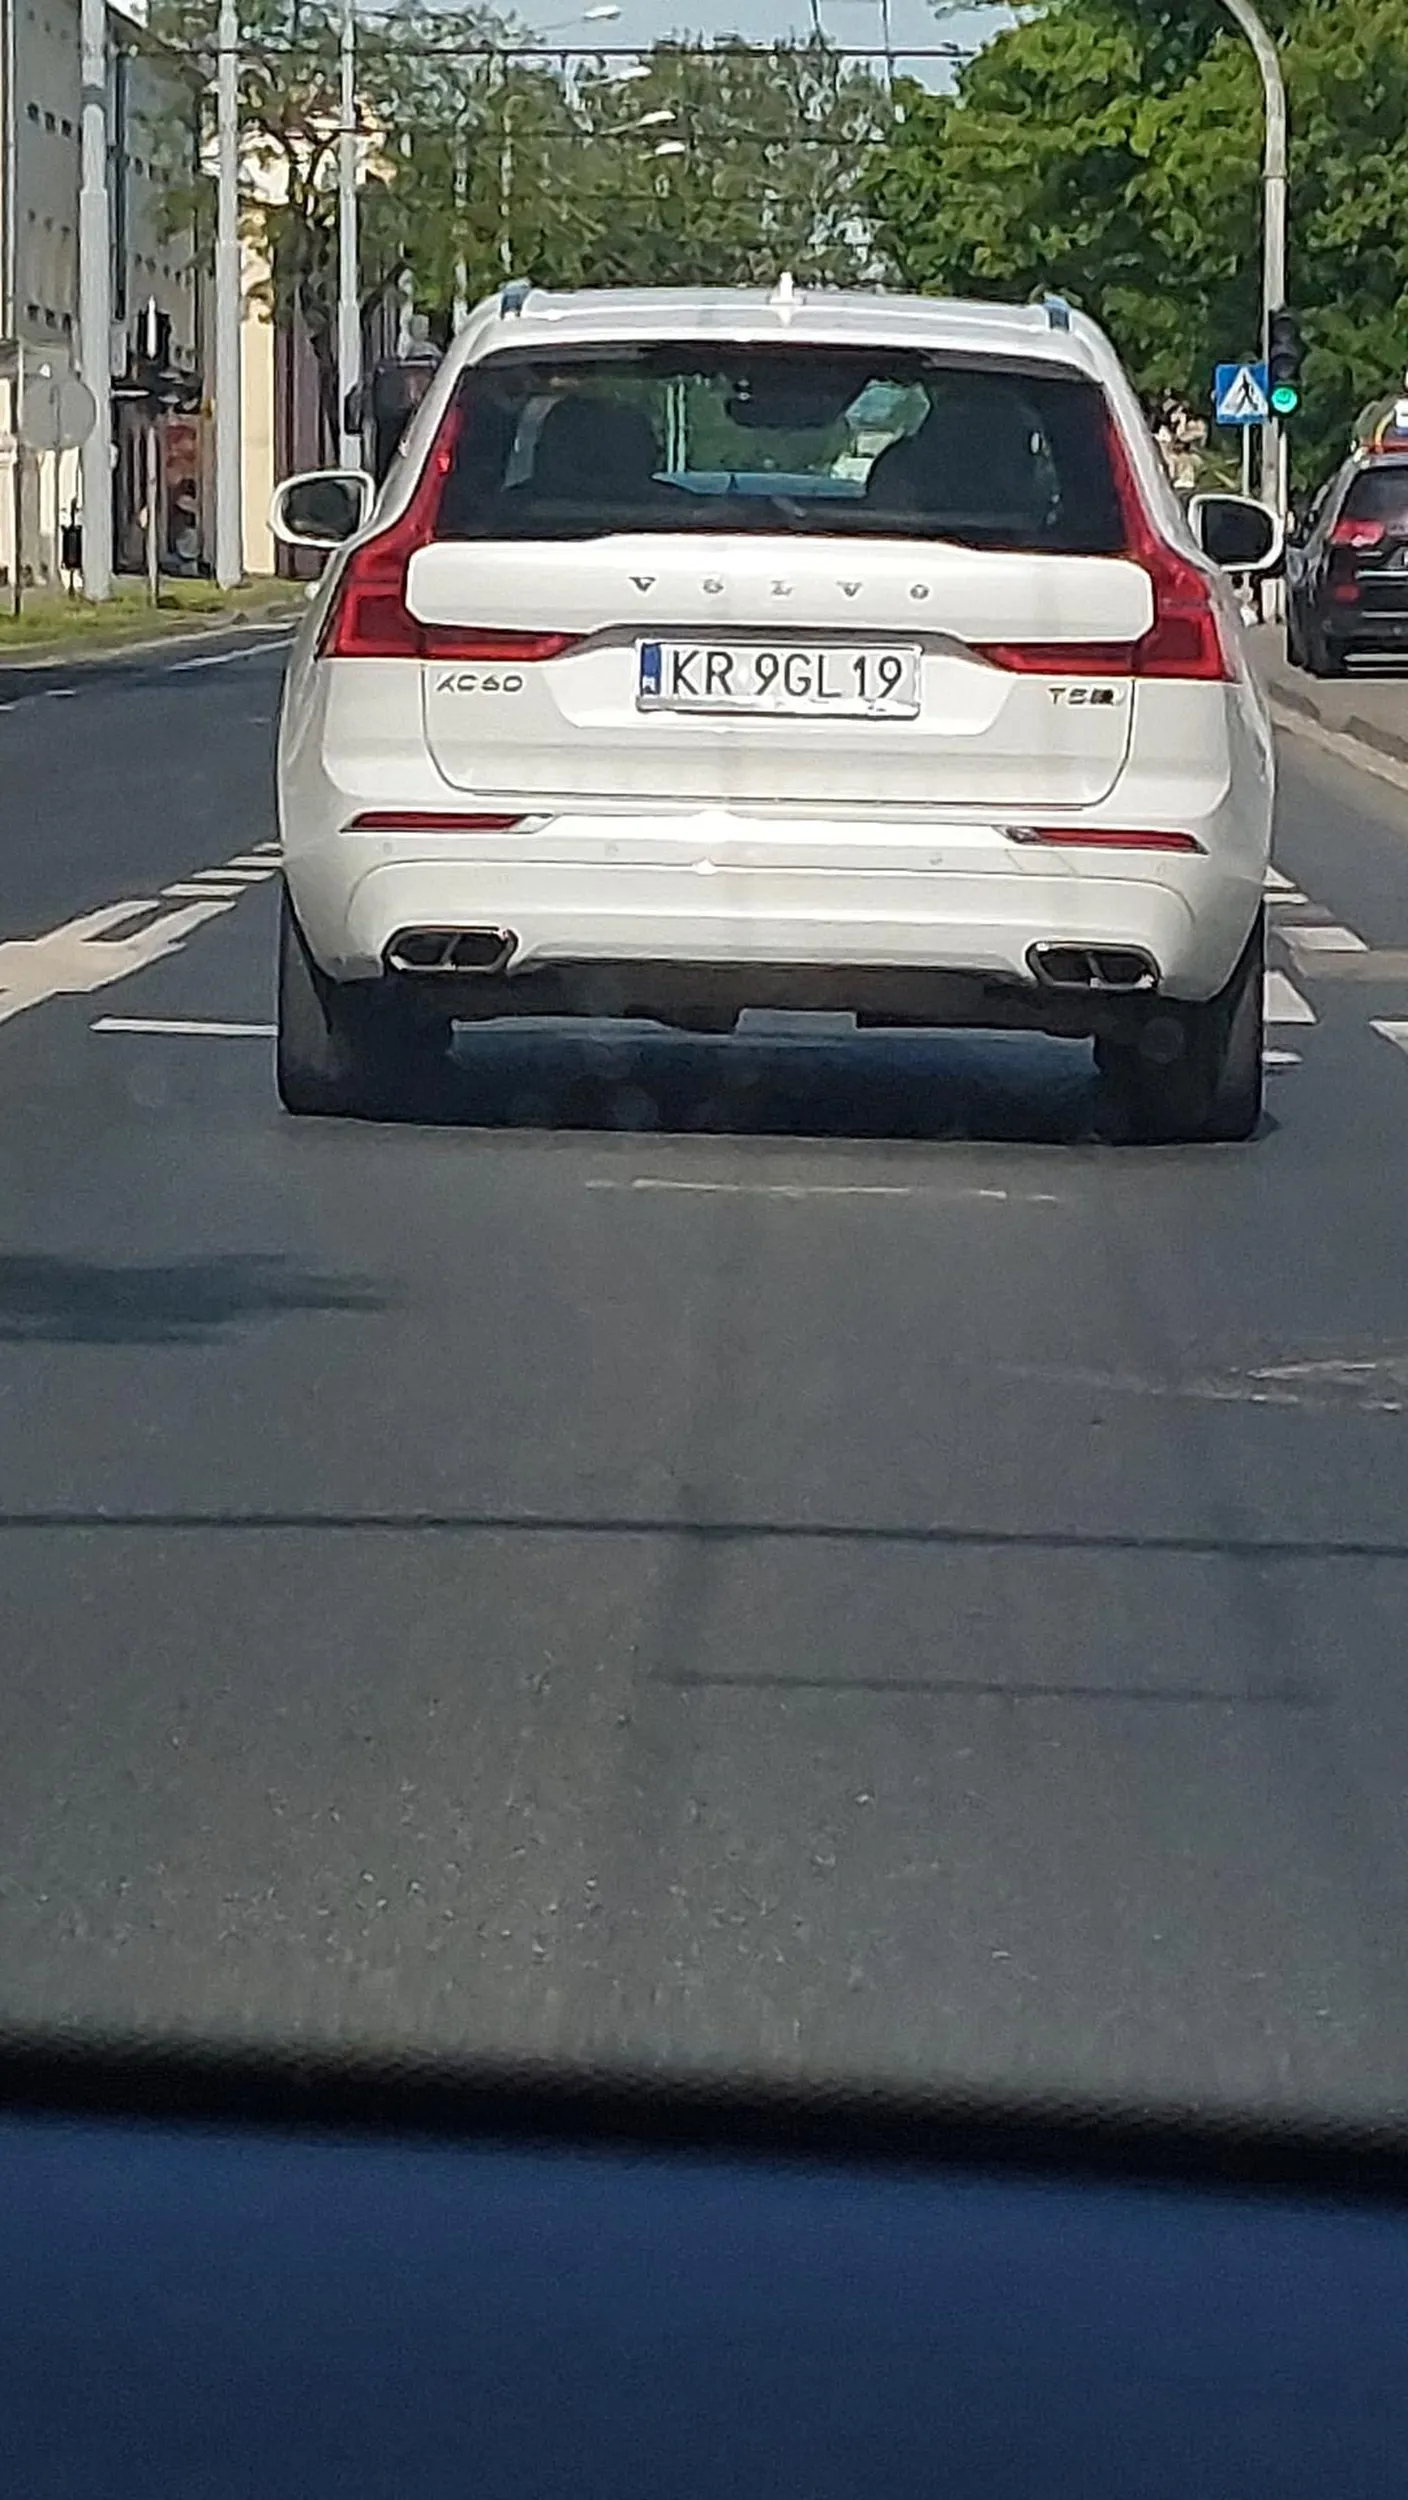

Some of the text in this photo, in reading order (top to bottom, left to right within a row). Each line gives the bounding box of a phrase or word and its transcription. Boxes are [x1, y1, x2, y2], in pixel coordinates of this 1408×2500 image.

[629, 576, 929, 599] VOLVO
[437, 674, 523, 692] XC60
[672, 650, 902, 699] KR 9GL19
